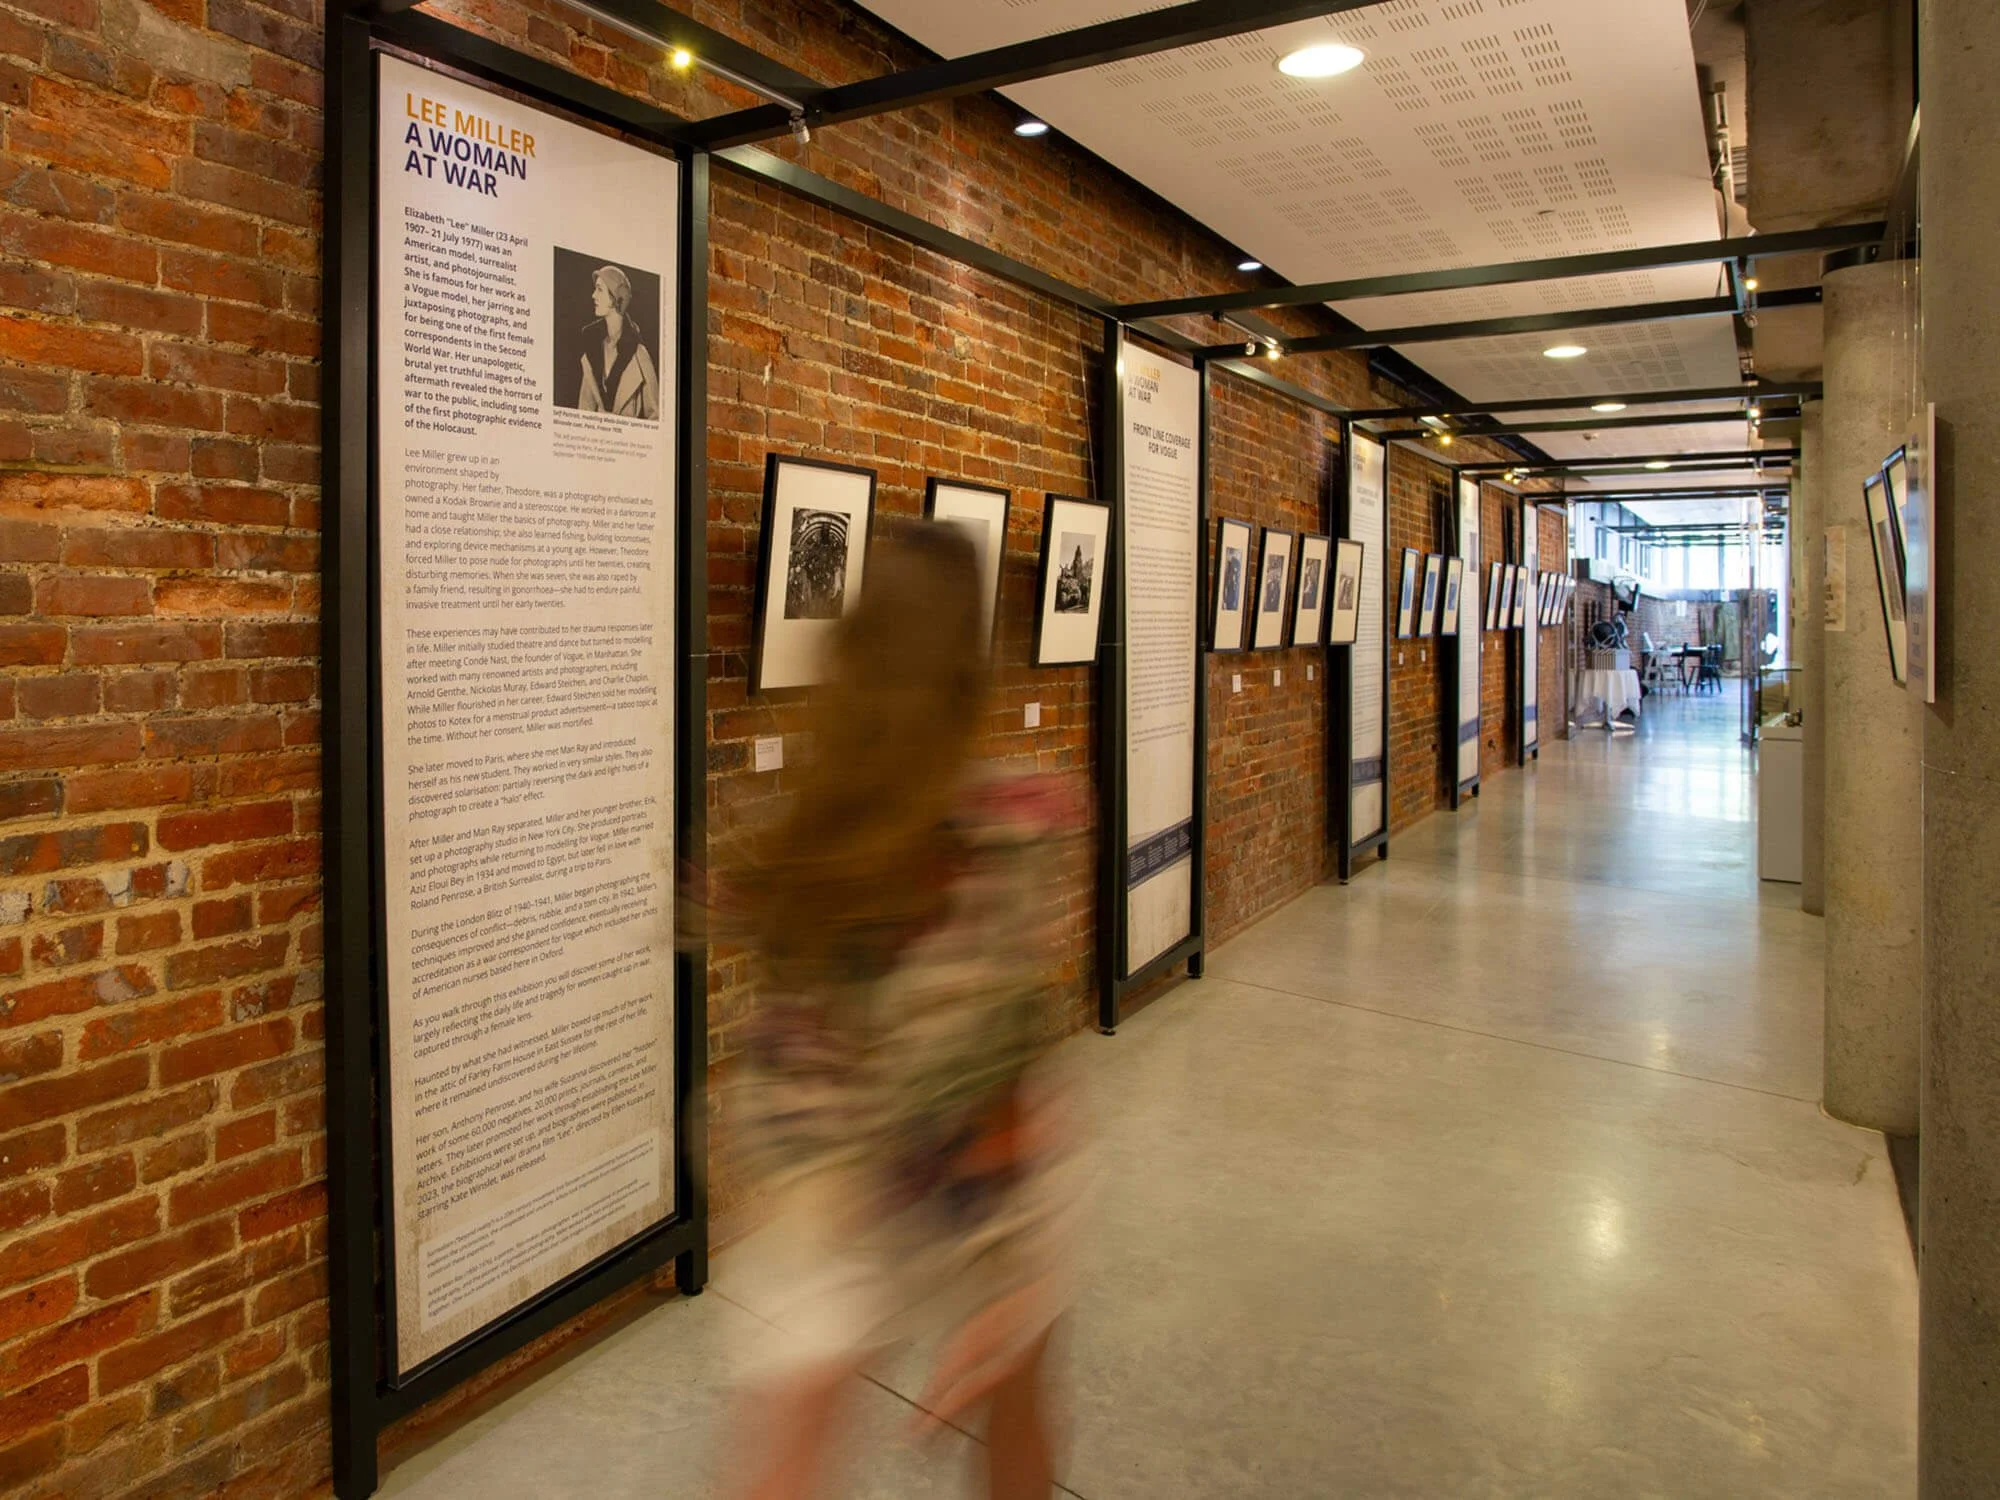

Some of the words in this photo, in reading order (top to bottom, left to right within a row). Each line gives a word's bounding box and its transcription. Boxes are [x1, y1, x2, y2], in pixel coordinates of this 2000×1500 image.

[406, 93, 447, 128] LEE
[455, 110, 536, 158] MILLER
[405, 122, 423, 148] A
[429, 128, 526, 180] WOMAN
[404, 150, 437, 178] AT
[443, 160, 498, 198] WAR
[405, 206, 444, 225] Elizabeth
[471, 223, 494, 238] Miller
[496, 230, 508, 241] (23
[509, 233, 528, 247] April
[404, 236, 446, 255] American
[449, 249, 477, 264] model,
[479, 256, 516, 272] surrealist
[431, 228, 441, 238] 21
[443, 230, 459, 245] July
[462, 235, 483, 250] 1977)
[484, 243, 500, 253] was
[502, 248, 512, 256] an
[404, 266, 420, 278] She
[423, 270, 430, 280] is
[432, 272, 464, 288] famous
[466, 280, 477, 291] for
[480, 283, 493, 294] her
[495, 288, 515, 299] work
[517, 293, 525, 301] as
[405, 254, 431, 267] artist,
[433, 260, 450, 270] and
[452, 263, 514, 285] photojournalist.
[404, 296, 455, 317] juxtaposing
[457, 308, 509, 327] photographs,
[513, 320, 527, 329] and
[412, 283, 439, 297] Vogue
[441, 291, 470, 305] model,
[472, 296, 485, 307] her
[487, 299, 514, 315] jarring
[516, 307, 530, 316] and
[404, 329, 472, 347] correspondents
[474, 339, 481, 349] in
[484, 342, 497, 352] the
[499, 344, 527, 357] Second
[405, 312, 417, 322] for
[420, 314, 444, 330] being
[445, 321, 461, 331] one
[463, 324, 472, 333] of
[474, 325, 487, 336] the
[490, 328, 505, 339] first
[508, 331, 534, 344] female
[404, 342, 431, 355] World
[433, 347, 452, 358] War.
[455, 350, 470, 361] Her
[404, 357, 432, 370] brutal
[434, 364, 447, 373] yet
[449, 365, 482, 378] truthful
[484, 370, 512, 384] images
[514, 375, 522, 384] of
[524, 376, 536, 386] the
[405, 374, 449, 388] aftermath
[451, 382, 487, 393] revealed
[489, 385, 502, 395] the
[504, 387, 533, 399] horrors
[534, 392, 542, 400] of
[405, 390, 422, 398] war
[424, 391, 433, 400] to
[435, 392, 450, 402] the
[481, 398, 517, 414] including
[518, 406, 539, 414] some
[1138, 388, 1151, 404] WAR
[405, 404, 414, 413] of
[416, 405, 431, 415] the
[433, 407, 450, 417] first
[452, 410, 506, 425] photographic
[508, 417, 542, 429] evidence
[405, 419, 414, 428] of
[416, 420, 430, 430] the
[433, 422, 477, 435] Holocaust.
[1133, 422, 1151, 437] FRONT
[1152, 429, 1164, 441] LINE
[1165, 433, 1191, 449] COVERAGE
[1148, 442, 1159, 454] FOR
[1160, 446, 1178, 459] VOGUE
[405, 449, 420, 457] Lee
[422, 450, 446, 460] Miller
[447, 454, 467, 462] grew
[469, 456, 479, 464] up
[481, 455, 488, 463] in
[433, 628, 480, 639] experiences
[482, 629, 499, 637] may
[407, 766, 424, 775] She
[425, 764, 444, 772] later
[446, 758, 473, 770] moved
[506, 753, 530, 762] where
[410, 927, 439, 940] During
[440, 922, 454, 932] the
[456, 915, 485, 928] London
[486, 910, 503, 920] Blitz
[504, 906, 512, 916] of
[413, 1019, 423, 1028] As
[425, 1014, 440, 1027] you
[441, 1006, 460, 1019] walk
[461, 996, 492, 1013] through
[493, 992, 507, 1003] this
[414, 1038, 450, 1058] captured
[452, 1027, 483, 1045] through
[490, 1017, 515, 1032] female
[417, 1200, 448, 1219] starring
[450, 1191, 468, 1204] Kate
[500, 1170, 514, 1182] was
